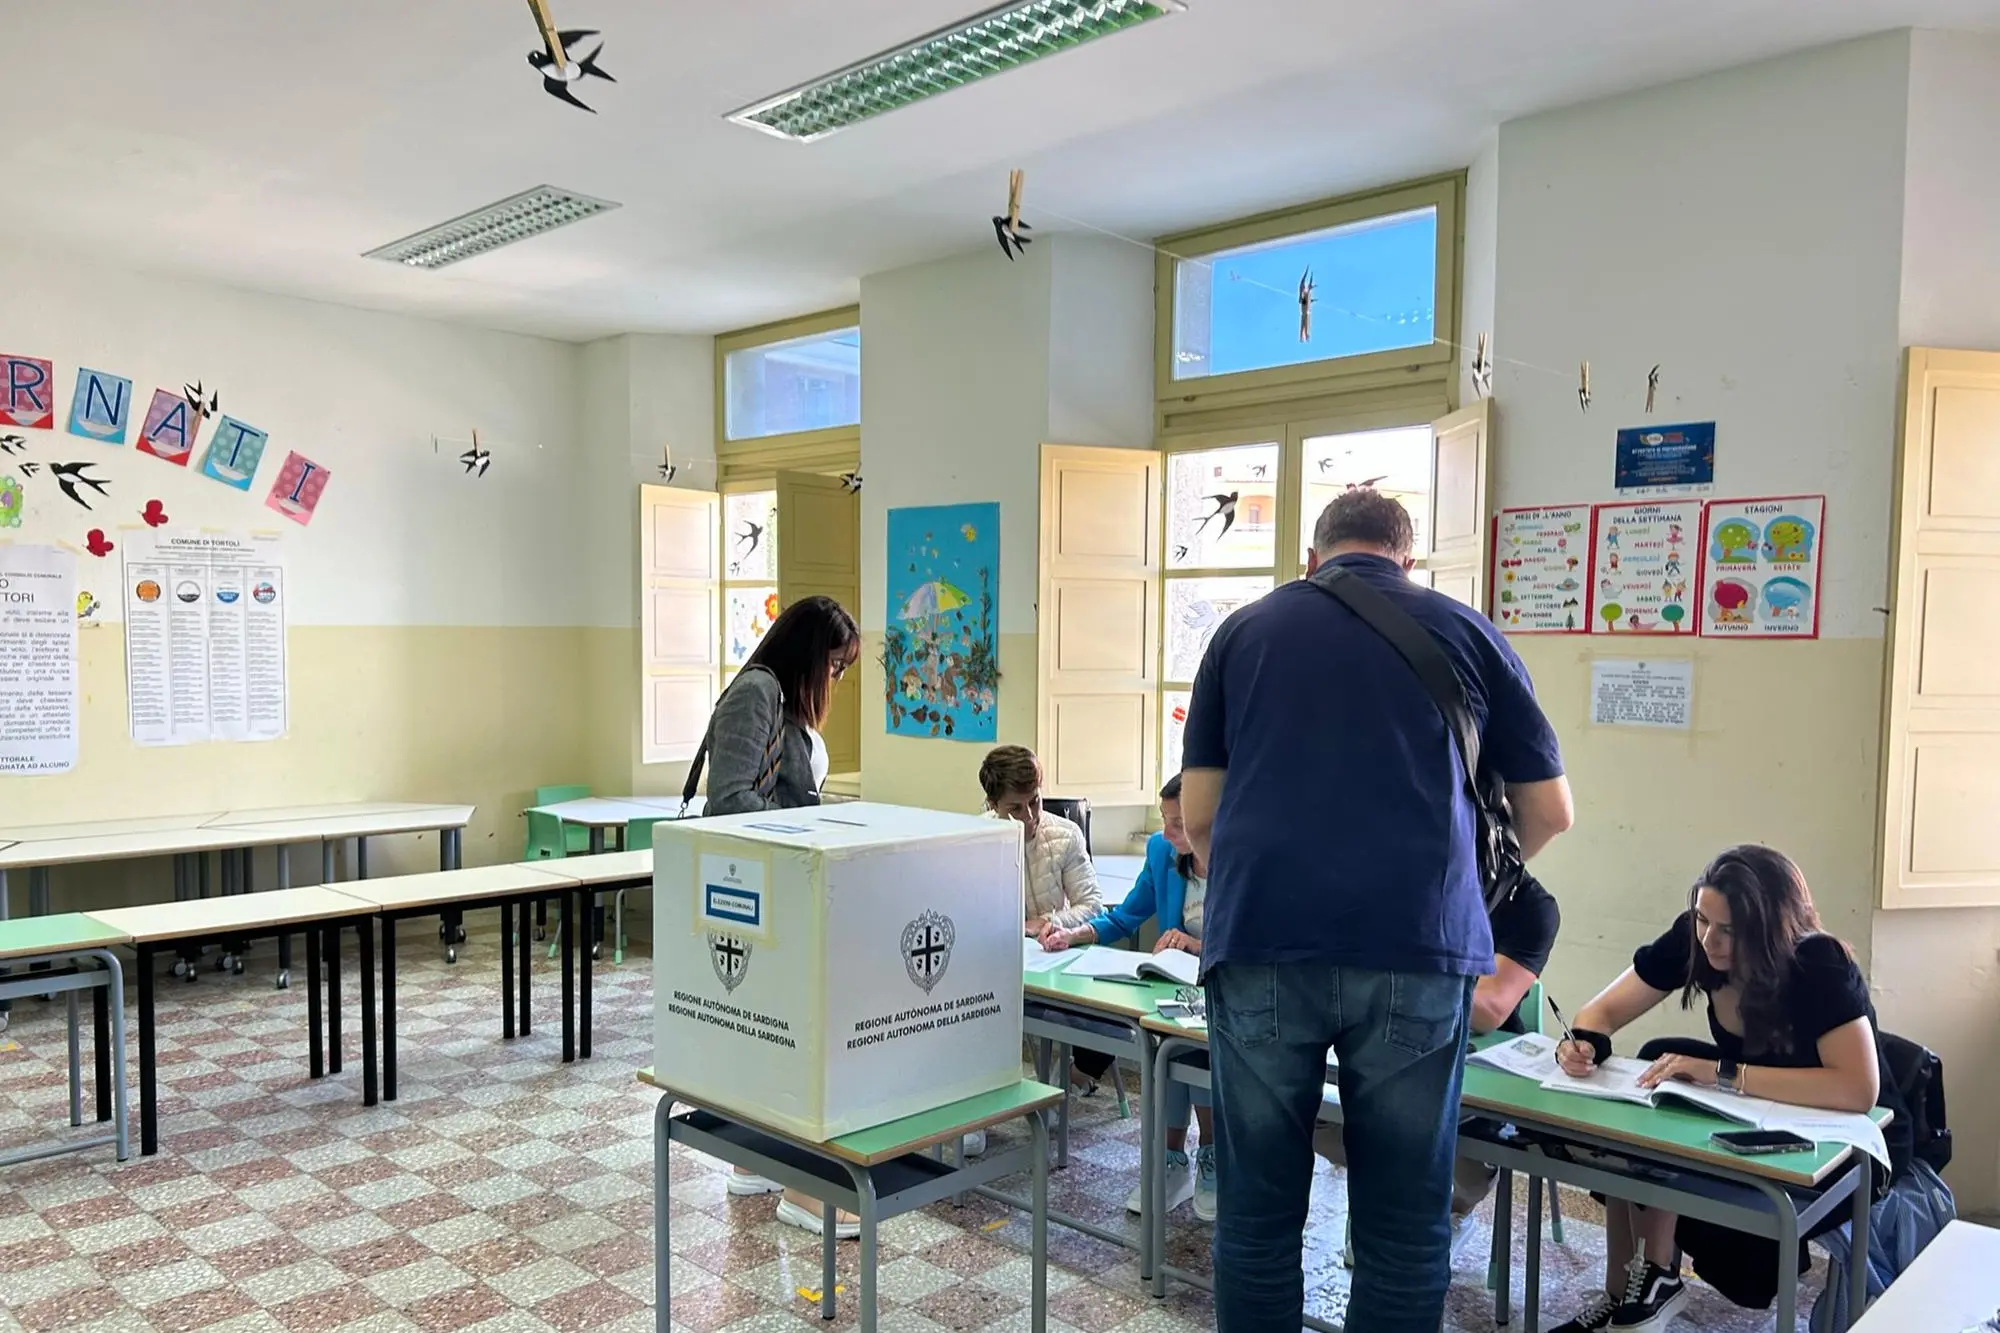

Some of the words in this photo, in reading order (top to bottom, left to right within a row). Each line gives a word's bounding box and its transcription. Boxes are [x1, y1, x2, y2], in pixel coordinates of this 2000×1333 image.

[1744, 504, 1783, 514] STAGIONI
[1613, 516, 1637, 524] DELLA
[1638, 514, 1682, 524] SETTIMANA
[1634, 539, 1664, 549] MARTEDÌ
[1636, 567, 1663, 576] GIOVEDÌ
[1716, 564, 1756, 572] PRIMAVERA
[1764, 624, 1799, 632] INVERNO
[40, 761, 70, 769] ALCUNO
[712, 897, 731, 907] ELEZIONI
[731, 901, 754, 911] COMUNALI
[673, 990, 702, 1006] REGIONE
[703, 999, 742, 1018] AUTÒNOMA
[742, 1010, 752, 1020] DE
[752, 1012, 790, 1031] SARDIGNA
[854, 1014, 893, 1033] REGIONE
[894, 1002, 943, 1022] AUTÒNOMA
[944, 1001, 955, 1011] DE
[955, 991, 995, 1009] SARDIGNA
[668, 1003, 697, 1020] REGIONE
[697, 1011, 736, 1031] AUTONOMA
[736, 1022, 757, 1037] DELLA
[757, 1028, 796, 1049] SARDEGNA
[846, 1031, 885, 1050] REGIONE
[886, 1020, 935, 1041] AUTONOMA
[936, 1013, 960, 1028] DELLA
[961, 1004, 1002, 1022] SARDEGNA
